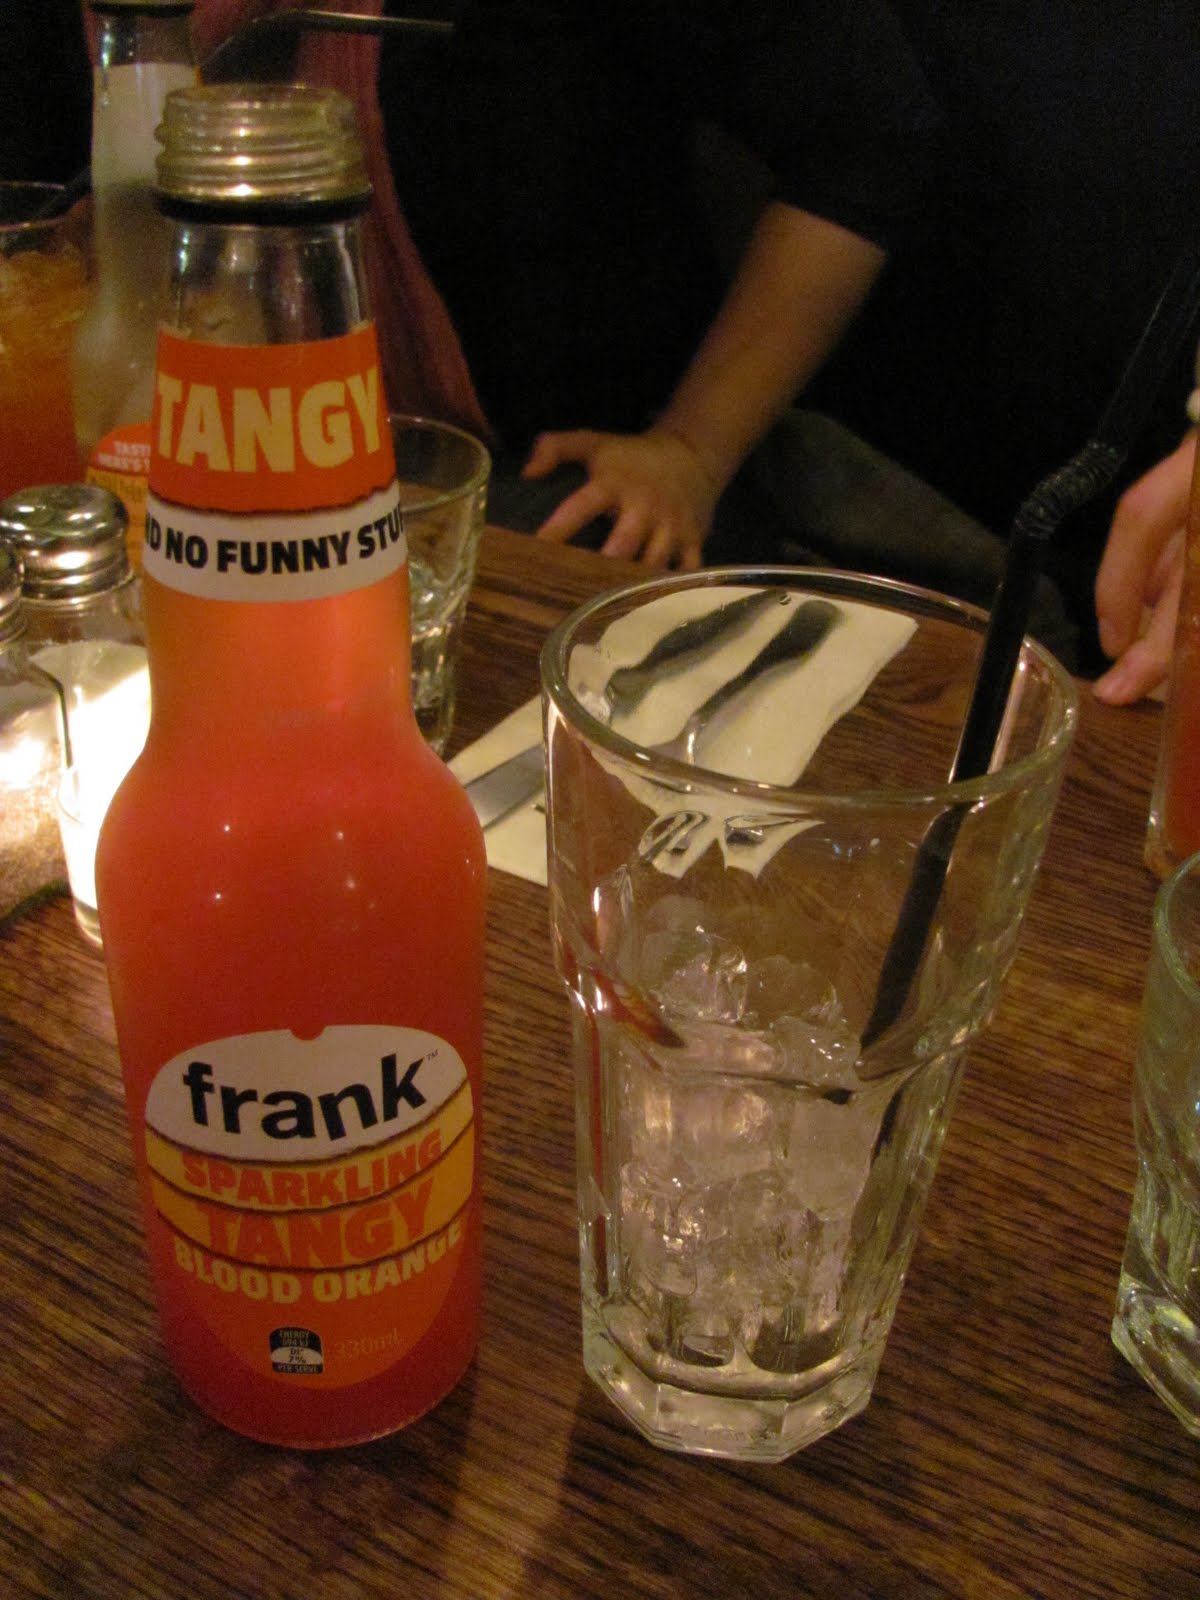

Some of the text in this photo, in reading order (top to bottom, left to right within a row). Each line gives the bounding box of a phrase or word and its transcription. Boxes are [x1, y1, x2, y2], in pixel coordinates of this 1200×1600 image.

[155, 366, 379, 473] TANGY
[165, 526, 209, 569] NO
[217, 530, 351, 575] FUNNY
[357, 502, 403, 559] STU
[182, 1053, 428, 1142] frank
[182, 1127, 444, 1208] SPARKLING
[174, 1217, 464, 1304] BLOOD ORANGE
[199, 1176, 436, 1268] TANGY
[279, 1329, 310, 1339] ENERGY
